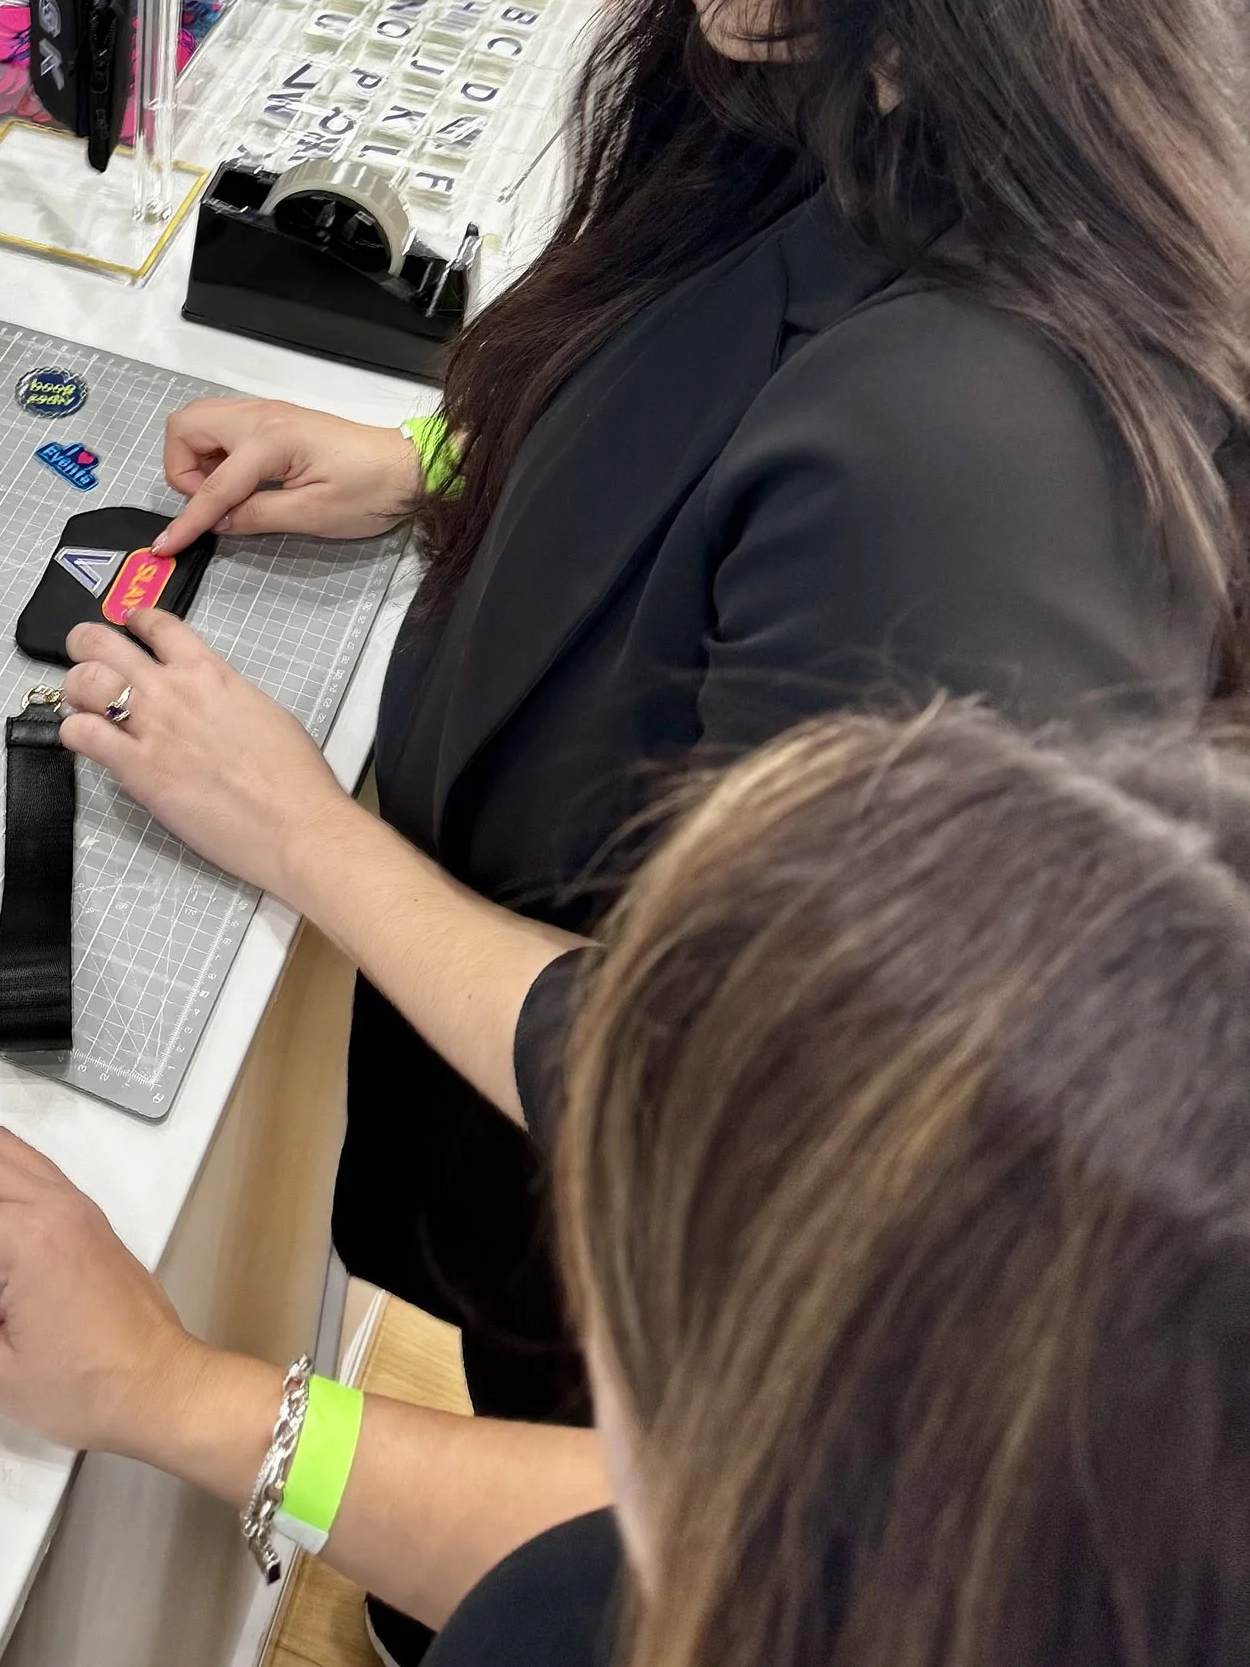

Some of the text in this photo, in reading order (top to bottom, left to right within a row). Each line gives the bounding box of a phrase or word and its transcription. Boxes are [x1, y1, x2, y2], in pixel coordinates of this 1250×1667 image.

[500, 5, 540, 26] B
[487, 36, 523, 57] C
[351, 67, 383, 90] P
[460, 81, 499, 102] D
[415, 171, 455, 193] F
